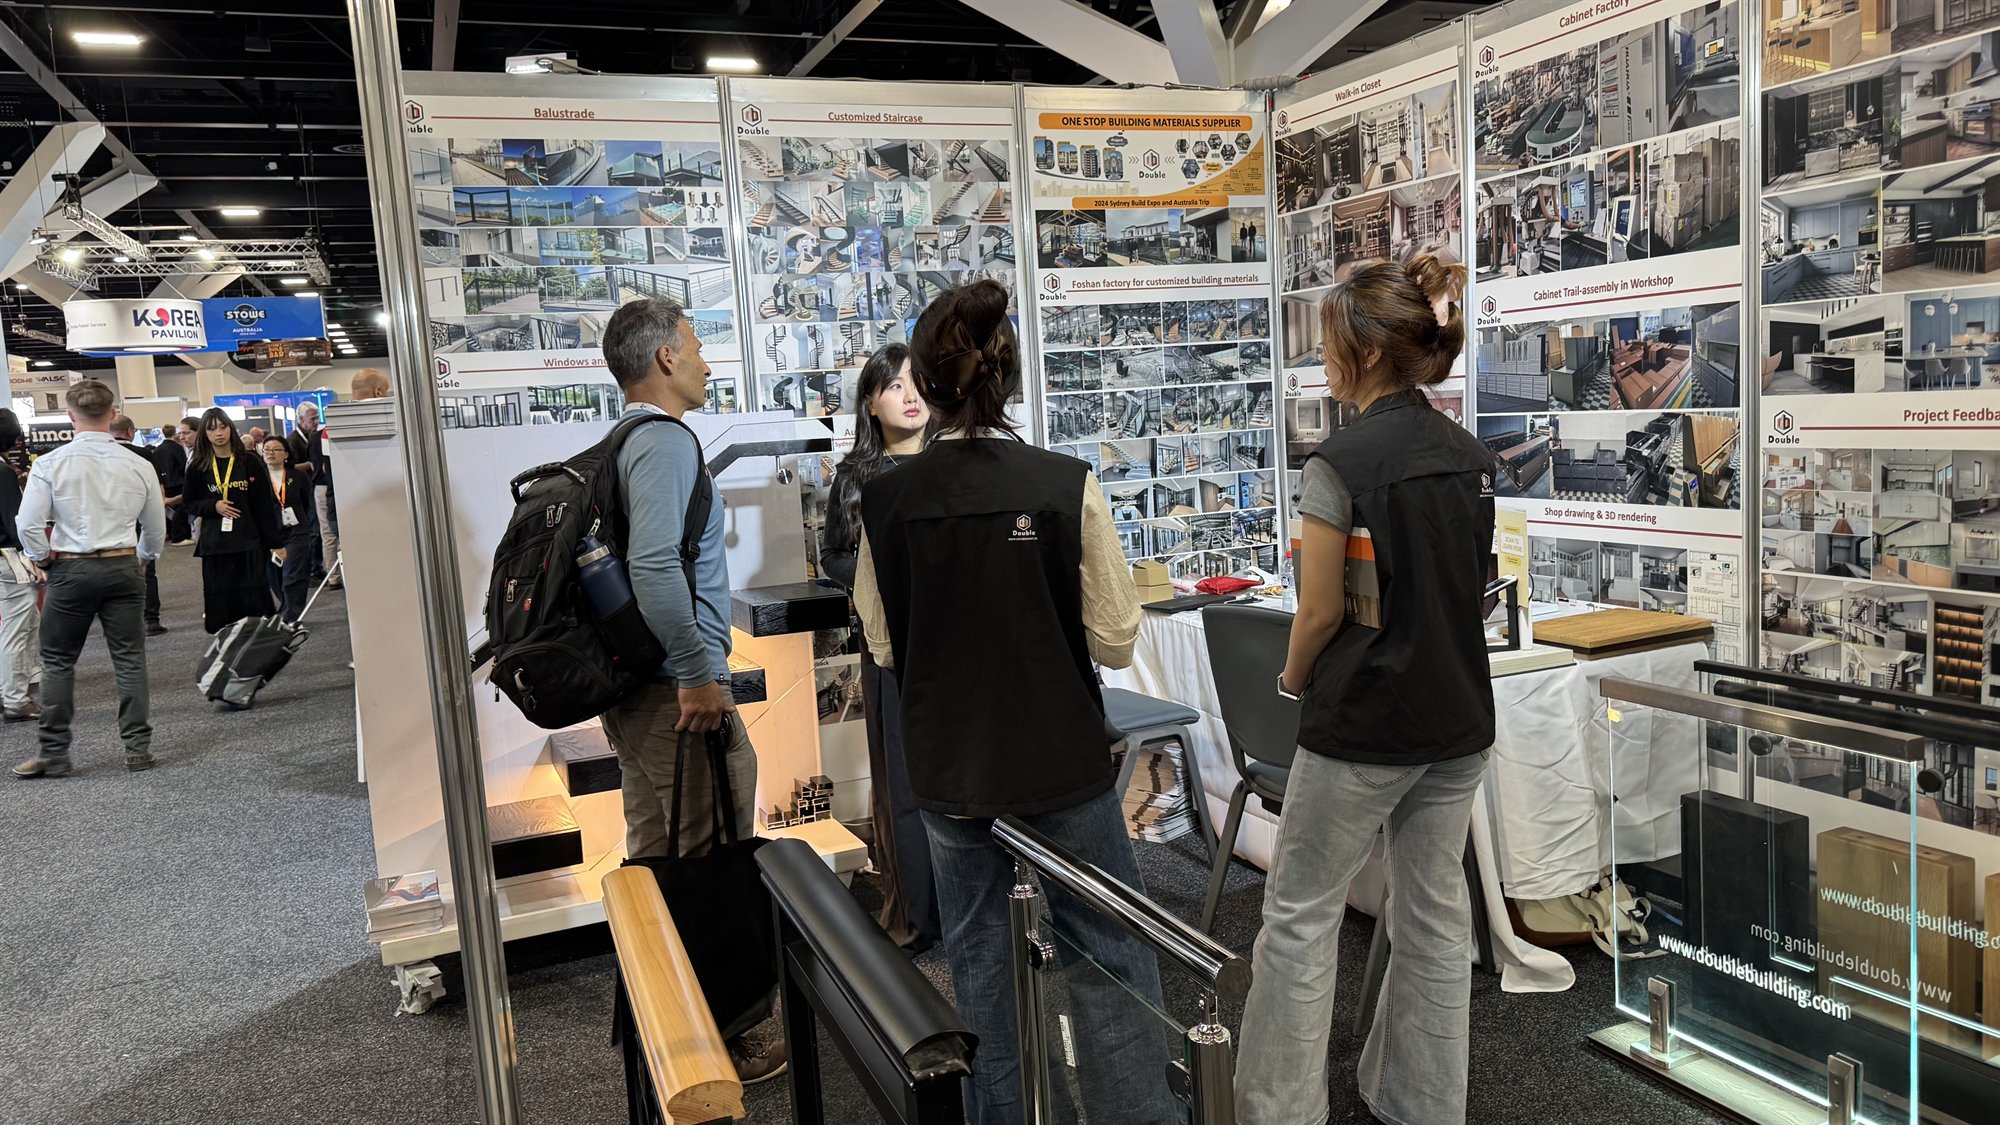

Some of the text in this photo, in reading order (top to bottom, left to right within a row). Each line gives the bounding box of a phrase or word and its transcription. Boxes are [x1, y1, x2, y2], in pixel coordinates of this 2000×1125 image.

[1559, 0, 1630, 28] Cabinet Factory
[1475, 65, 1500, 78] Double
[1335, 78, 1382, 102] Walk-in Closet
[534, 108, 595, 119] Balustrade
[828, 111, 923, 123] Customized Staircase
[1061, 116, 1241, 128] ONE STOP BUILDING MATERIALS SUPPLIER
[407, 125, 433, 133] uble
[737, 126, 770, 135] Double
[1275, 127, 1292, 137] Double
[1139, 169, 1166, 179] Double
[1109, 199, 1130, 208] Sydney
[1131, 199, 1146, 207] Build
[1147, 199, 1161, 208] Expo
[1173, 198, 1198, 206] Australia
[1199, 198, 1210, 207] Trip
[1072, 274, 1259, 289] Foshan factory for customized building materials
[1533, 275, 1674, 301] Cabinet Trail-assembly in Workshop
[1039, 293, 1066, 301] Double
[132, 308, 202, 328] KOREA
[226, 310, 265, 320] STOWE
[1477, 317, 1501, 325] Double
[151, 330, 199, 339] PAVILION
[543, 358, 590, 367] Windows
[437, 380, 460, 388] uble
[1903, 409, 1949, 424] Project
[31, 427, 73, 443] ima
[1768, 435, 1800, 444] Double
[1544, 506, 1657, 524] Shop drawing & 3D rendering
[1658, 934, 1851, 1021] www.doublebuilding.com
